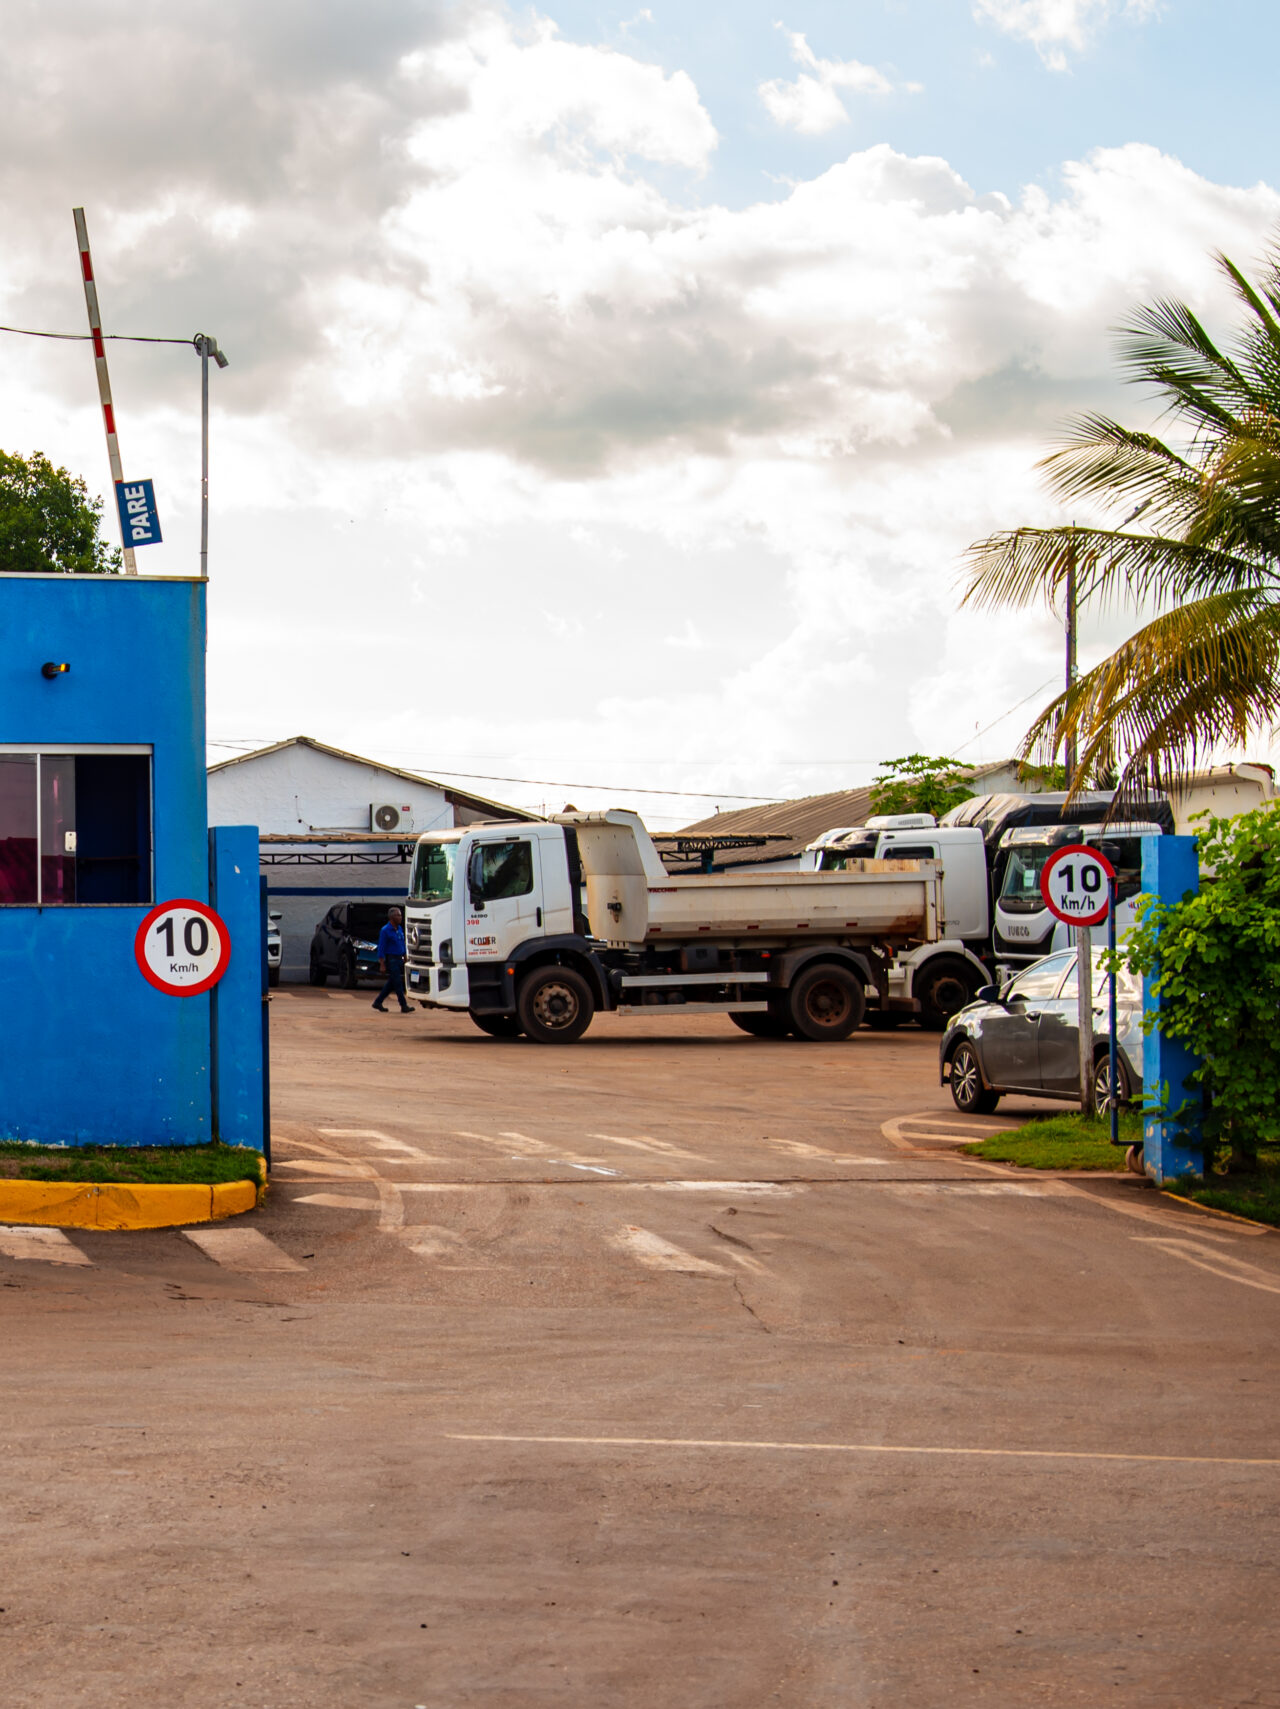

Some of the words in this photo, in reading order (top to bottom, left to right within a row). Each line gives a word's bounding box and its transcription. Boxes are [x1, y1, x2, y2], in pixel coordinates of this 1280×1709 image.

[124, 485, 152, 541] PARE
[1057, 865, 1101, 893] 10
[1061, 895, 1095, 910] Km/h
[156, 917, 209, 957] 10
[169, 963, 199, 973] Km/h
